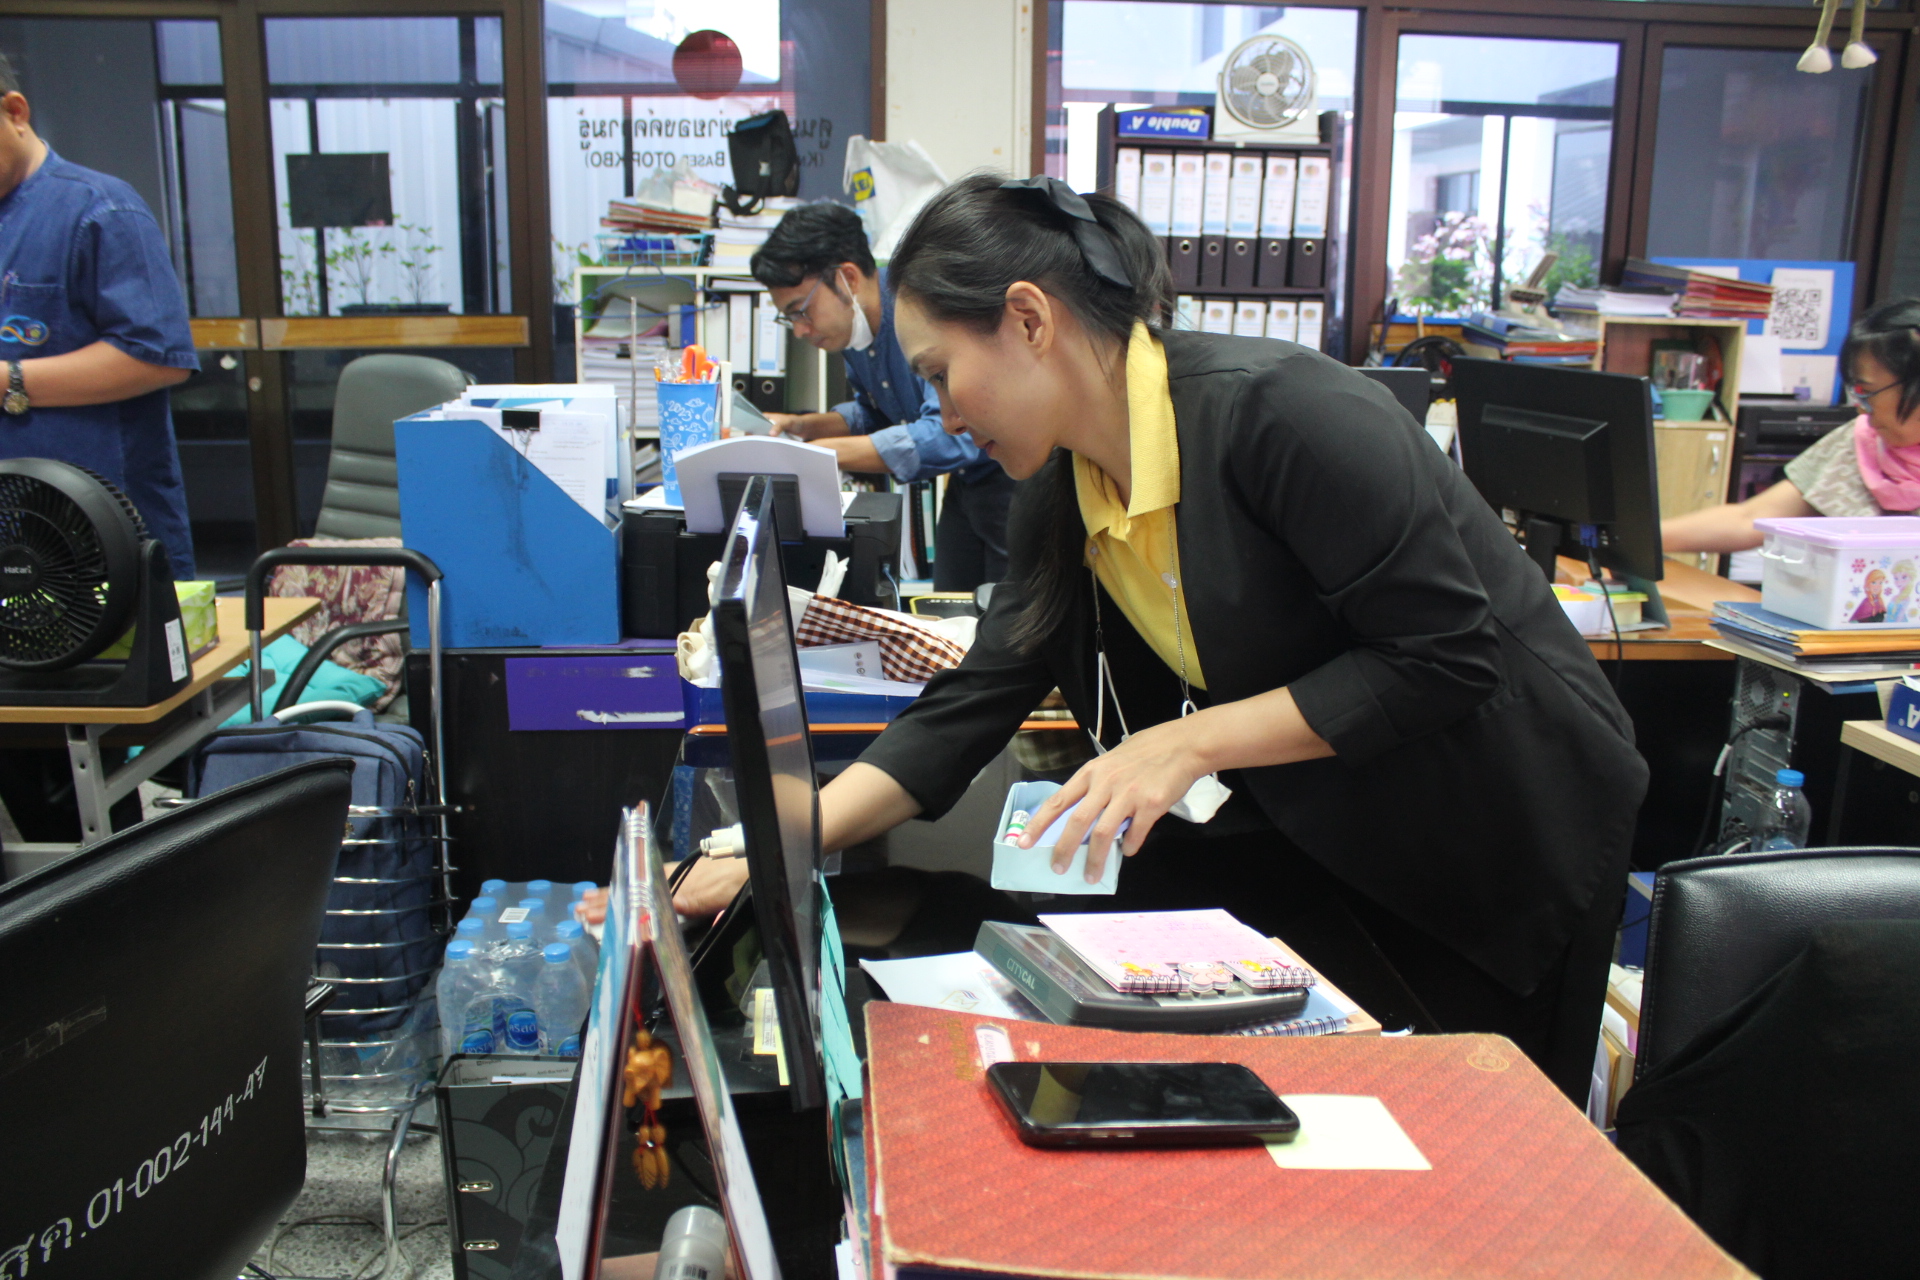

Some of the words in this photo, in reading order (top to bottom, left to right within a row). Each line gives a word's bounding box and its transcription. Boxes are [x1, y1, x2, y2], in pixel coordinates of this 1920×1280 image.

[1131, 115, 1145, 128] A
[1147, 115, 1202, 133] Double
[1006, 957, 1035, 990] CITYCAL
